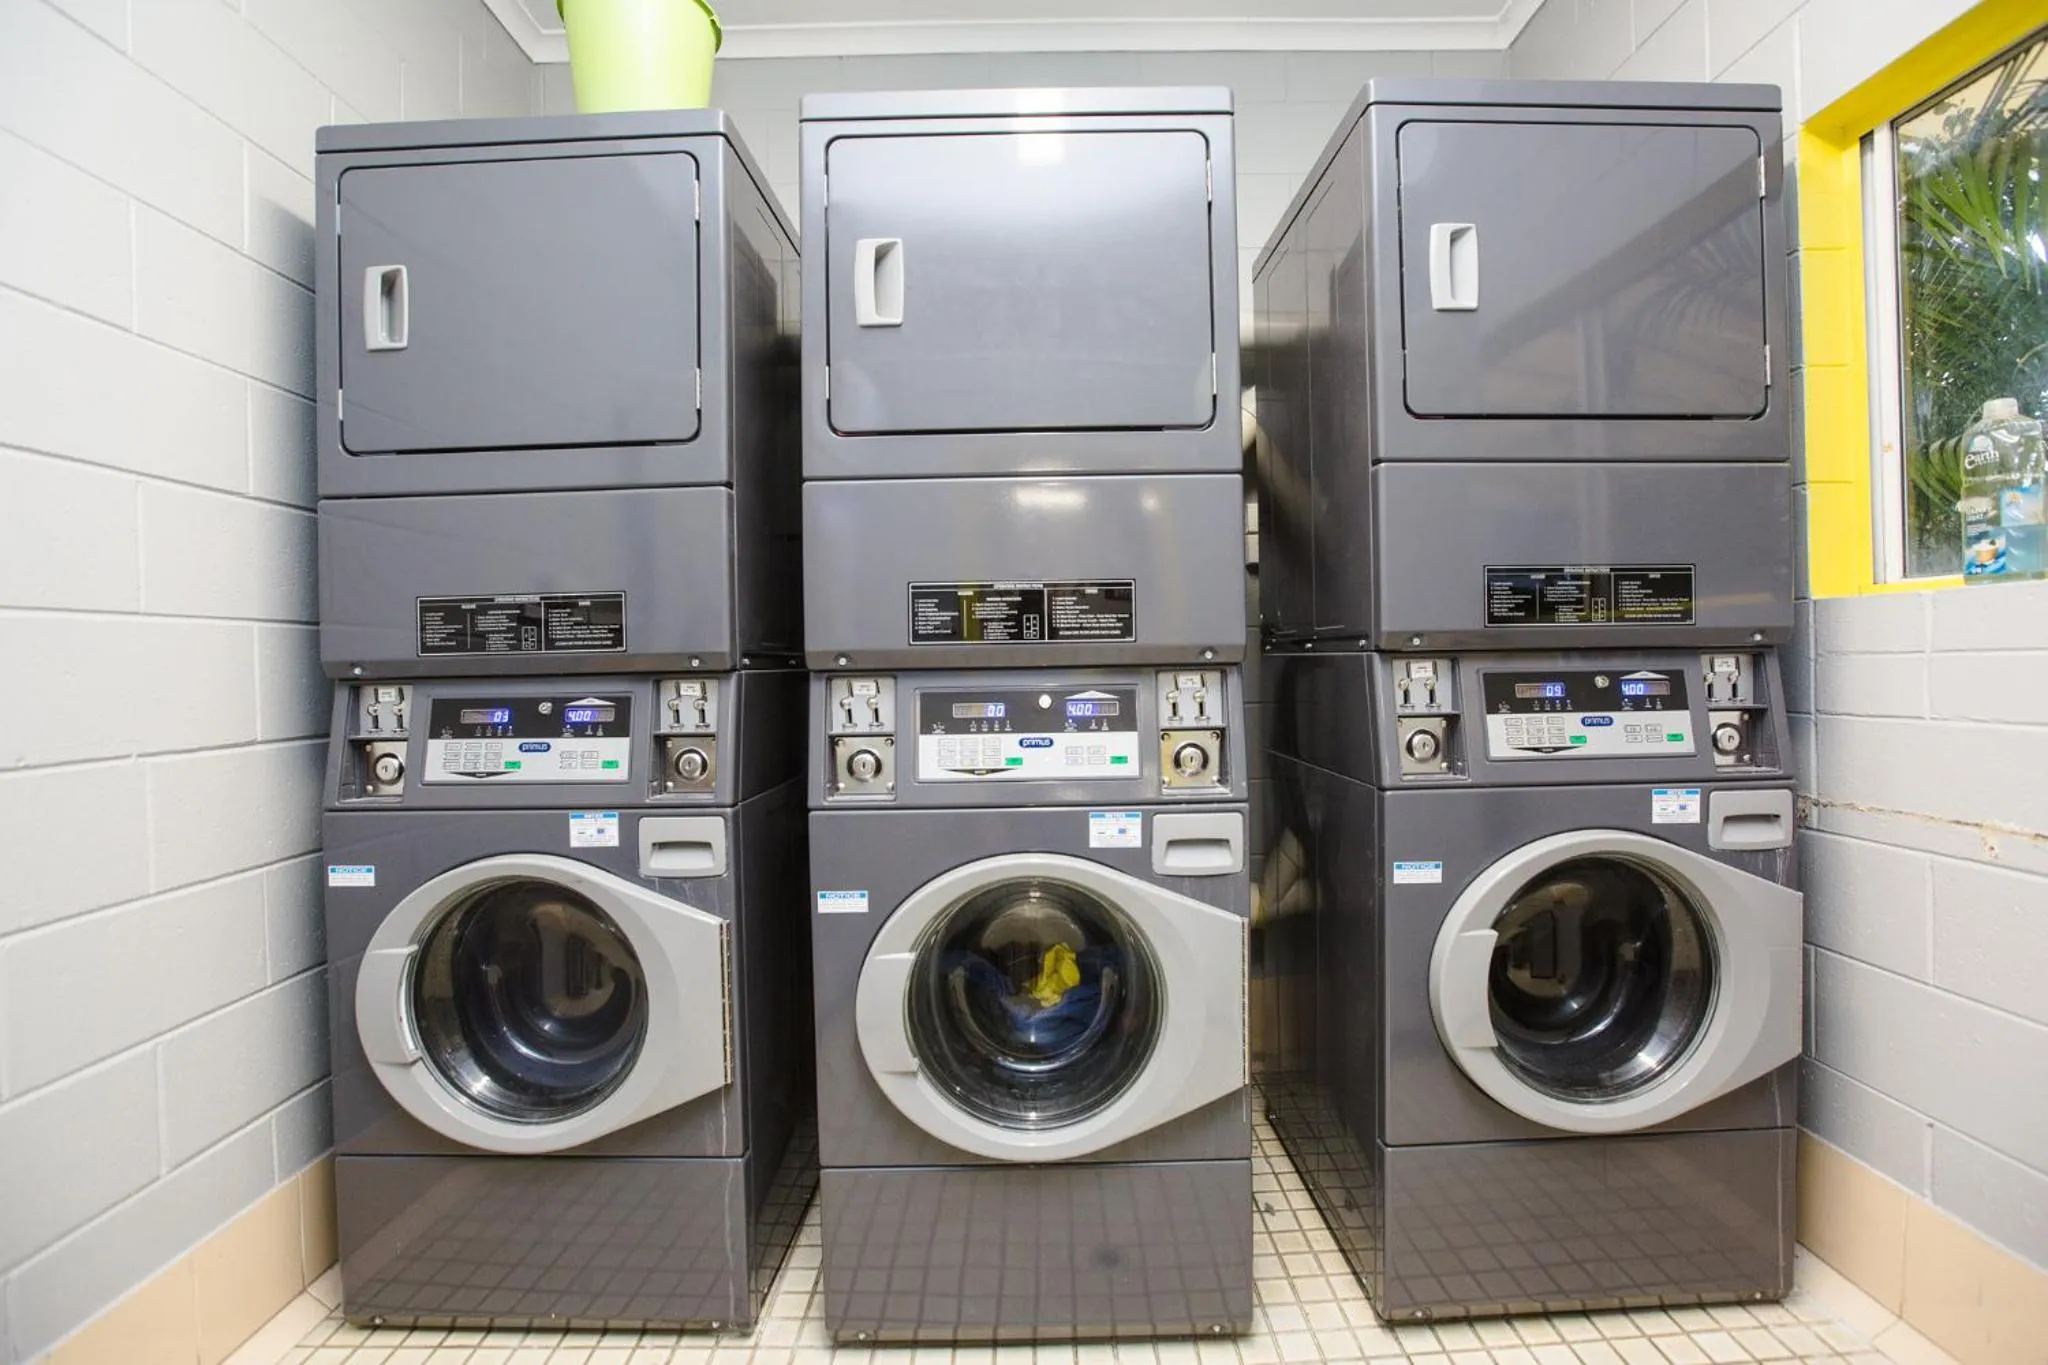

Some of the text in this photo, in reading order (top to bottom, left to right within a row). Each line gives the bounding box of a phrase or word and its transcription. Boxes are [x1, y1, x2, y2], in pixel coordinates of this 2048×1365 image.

[1584, 716, 1611, 726] primus
[522, 742, 549, 752] primus
[1022, 737, 1051, 748] primus
